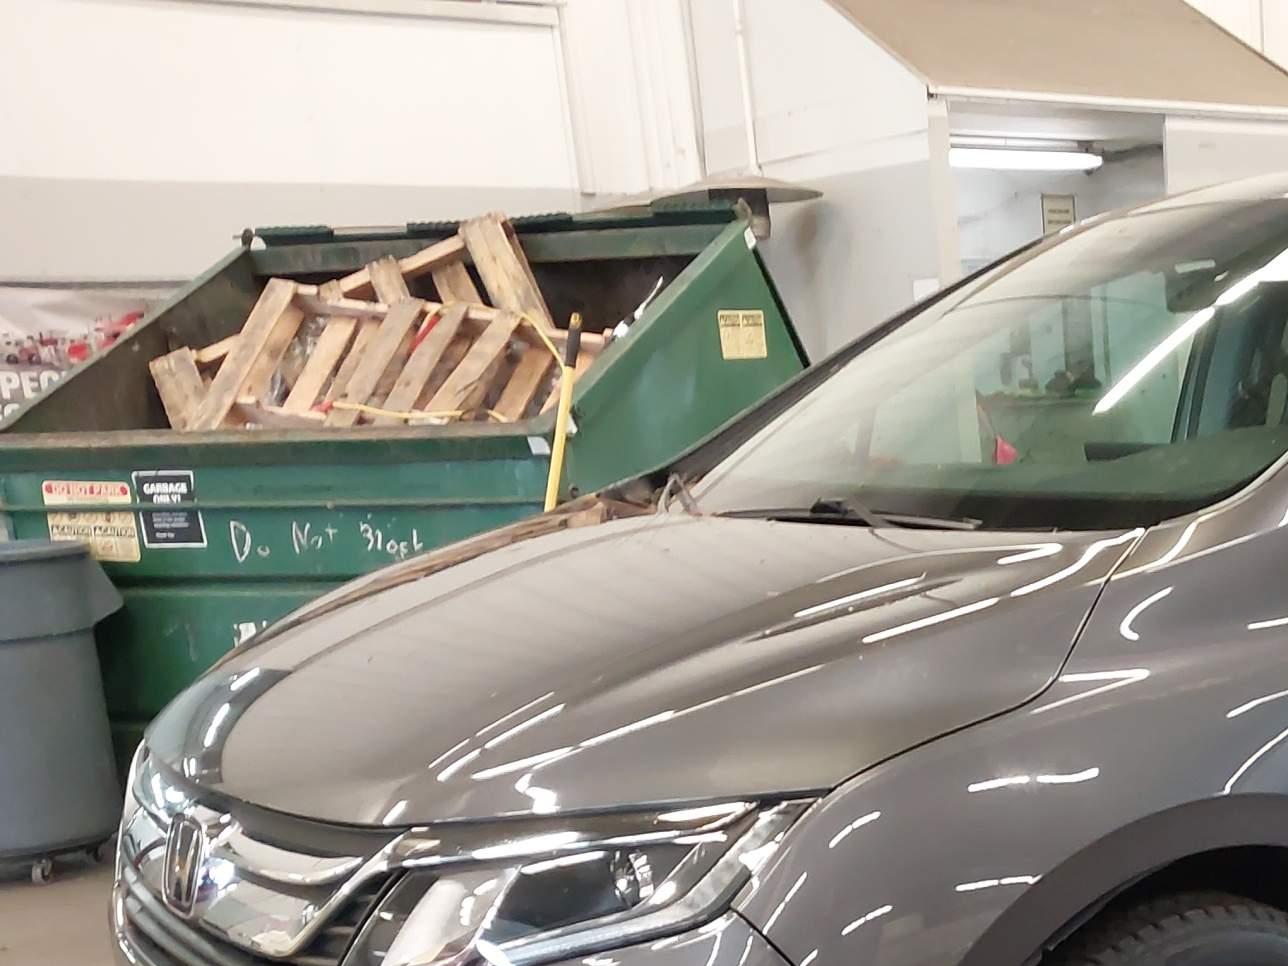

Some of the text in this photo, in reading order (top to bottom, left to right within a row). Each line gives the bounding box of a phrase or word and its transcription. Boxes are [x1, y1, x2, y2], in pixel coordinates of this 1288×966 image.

[143, 482, 187, 494] GARBAGE
[229, 520, 270, 563] Do
[292, 520, 338, 554] Not
